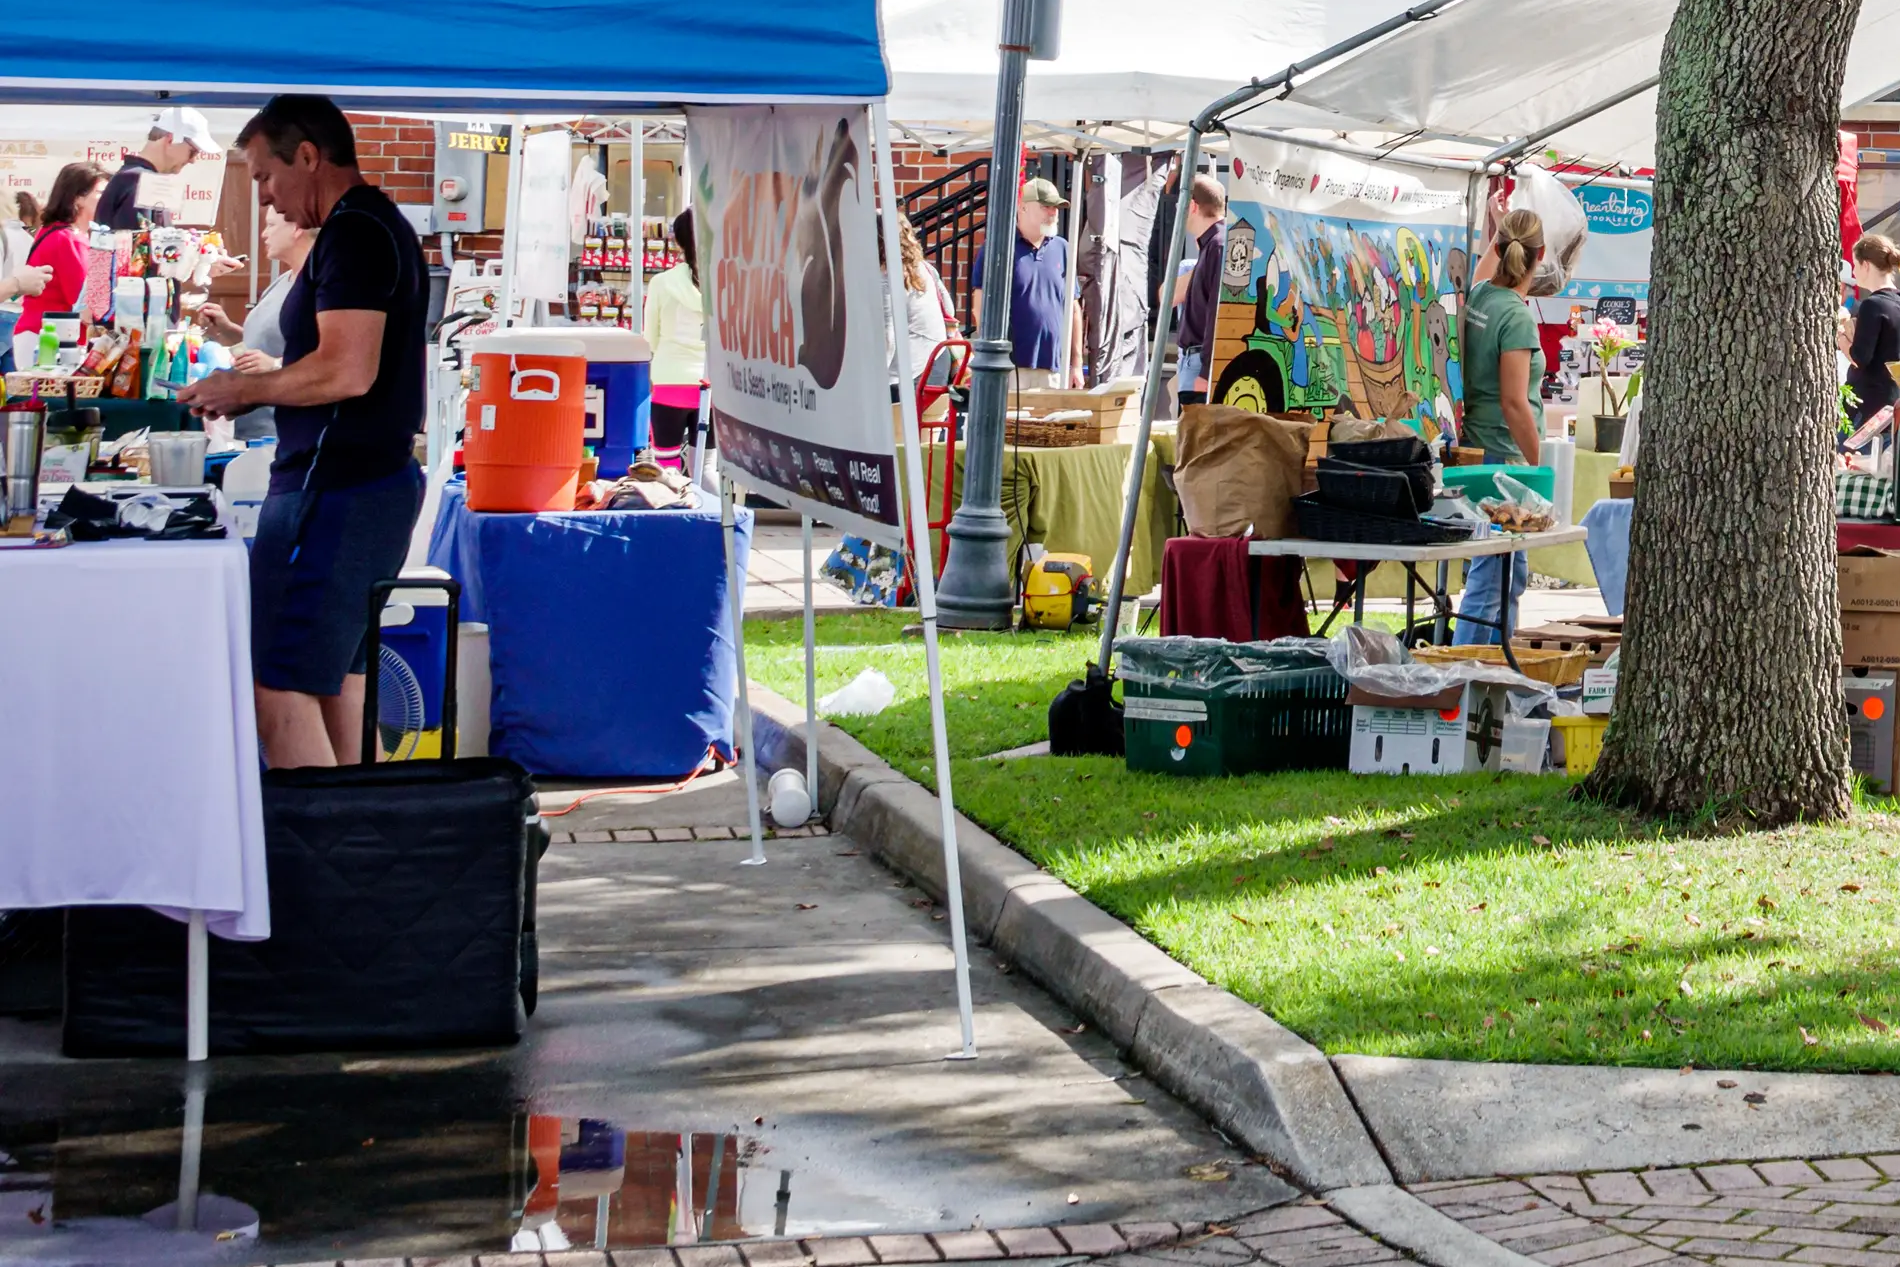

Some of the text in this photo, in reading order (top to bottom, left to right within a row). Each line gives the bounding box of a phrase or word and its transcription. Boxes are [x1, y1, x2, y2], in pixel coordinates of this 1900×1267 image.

[447, 131, 509, 152] JERKY
[87, 147, 115, 162] Free
[8, 174, 32, 187] Farm
[1273, 168, 1306, 191] Organics
[717, 258, 796, 369] CRUNCH
[1602, 300, 1631, 309] COOKIES
[749, 367, 766, 399] Seeds
[771, 373, 792, 414] Honey
[798, 379, 817, 411] Yum
[812, 451, 838, 475] Peanut
[849, 460, 859, 481] All
[860, 461, 882, 484] Real
